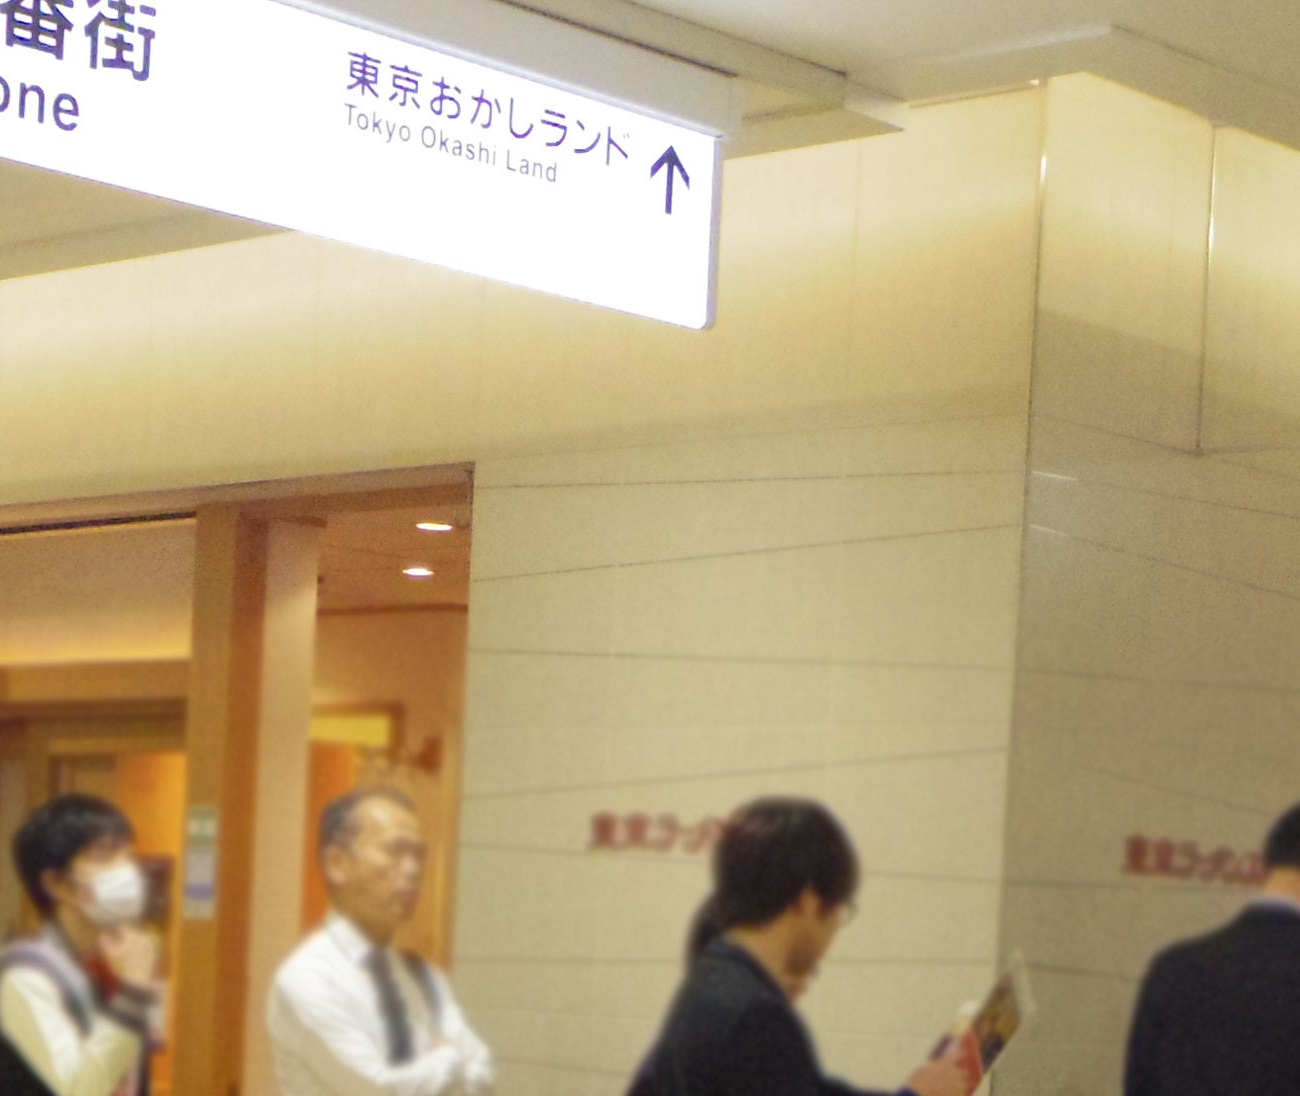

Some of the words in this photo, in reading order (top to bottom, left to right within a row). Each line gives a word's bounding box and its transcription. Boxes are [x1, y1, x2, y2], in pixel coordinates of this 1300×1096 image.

[345, 102, 411, 143] Tokyo
[421, 125, 497, 167] Okashi
[506, 149, 558, 183] Land
[346, 51, 631, 166] 東京おかしランド
